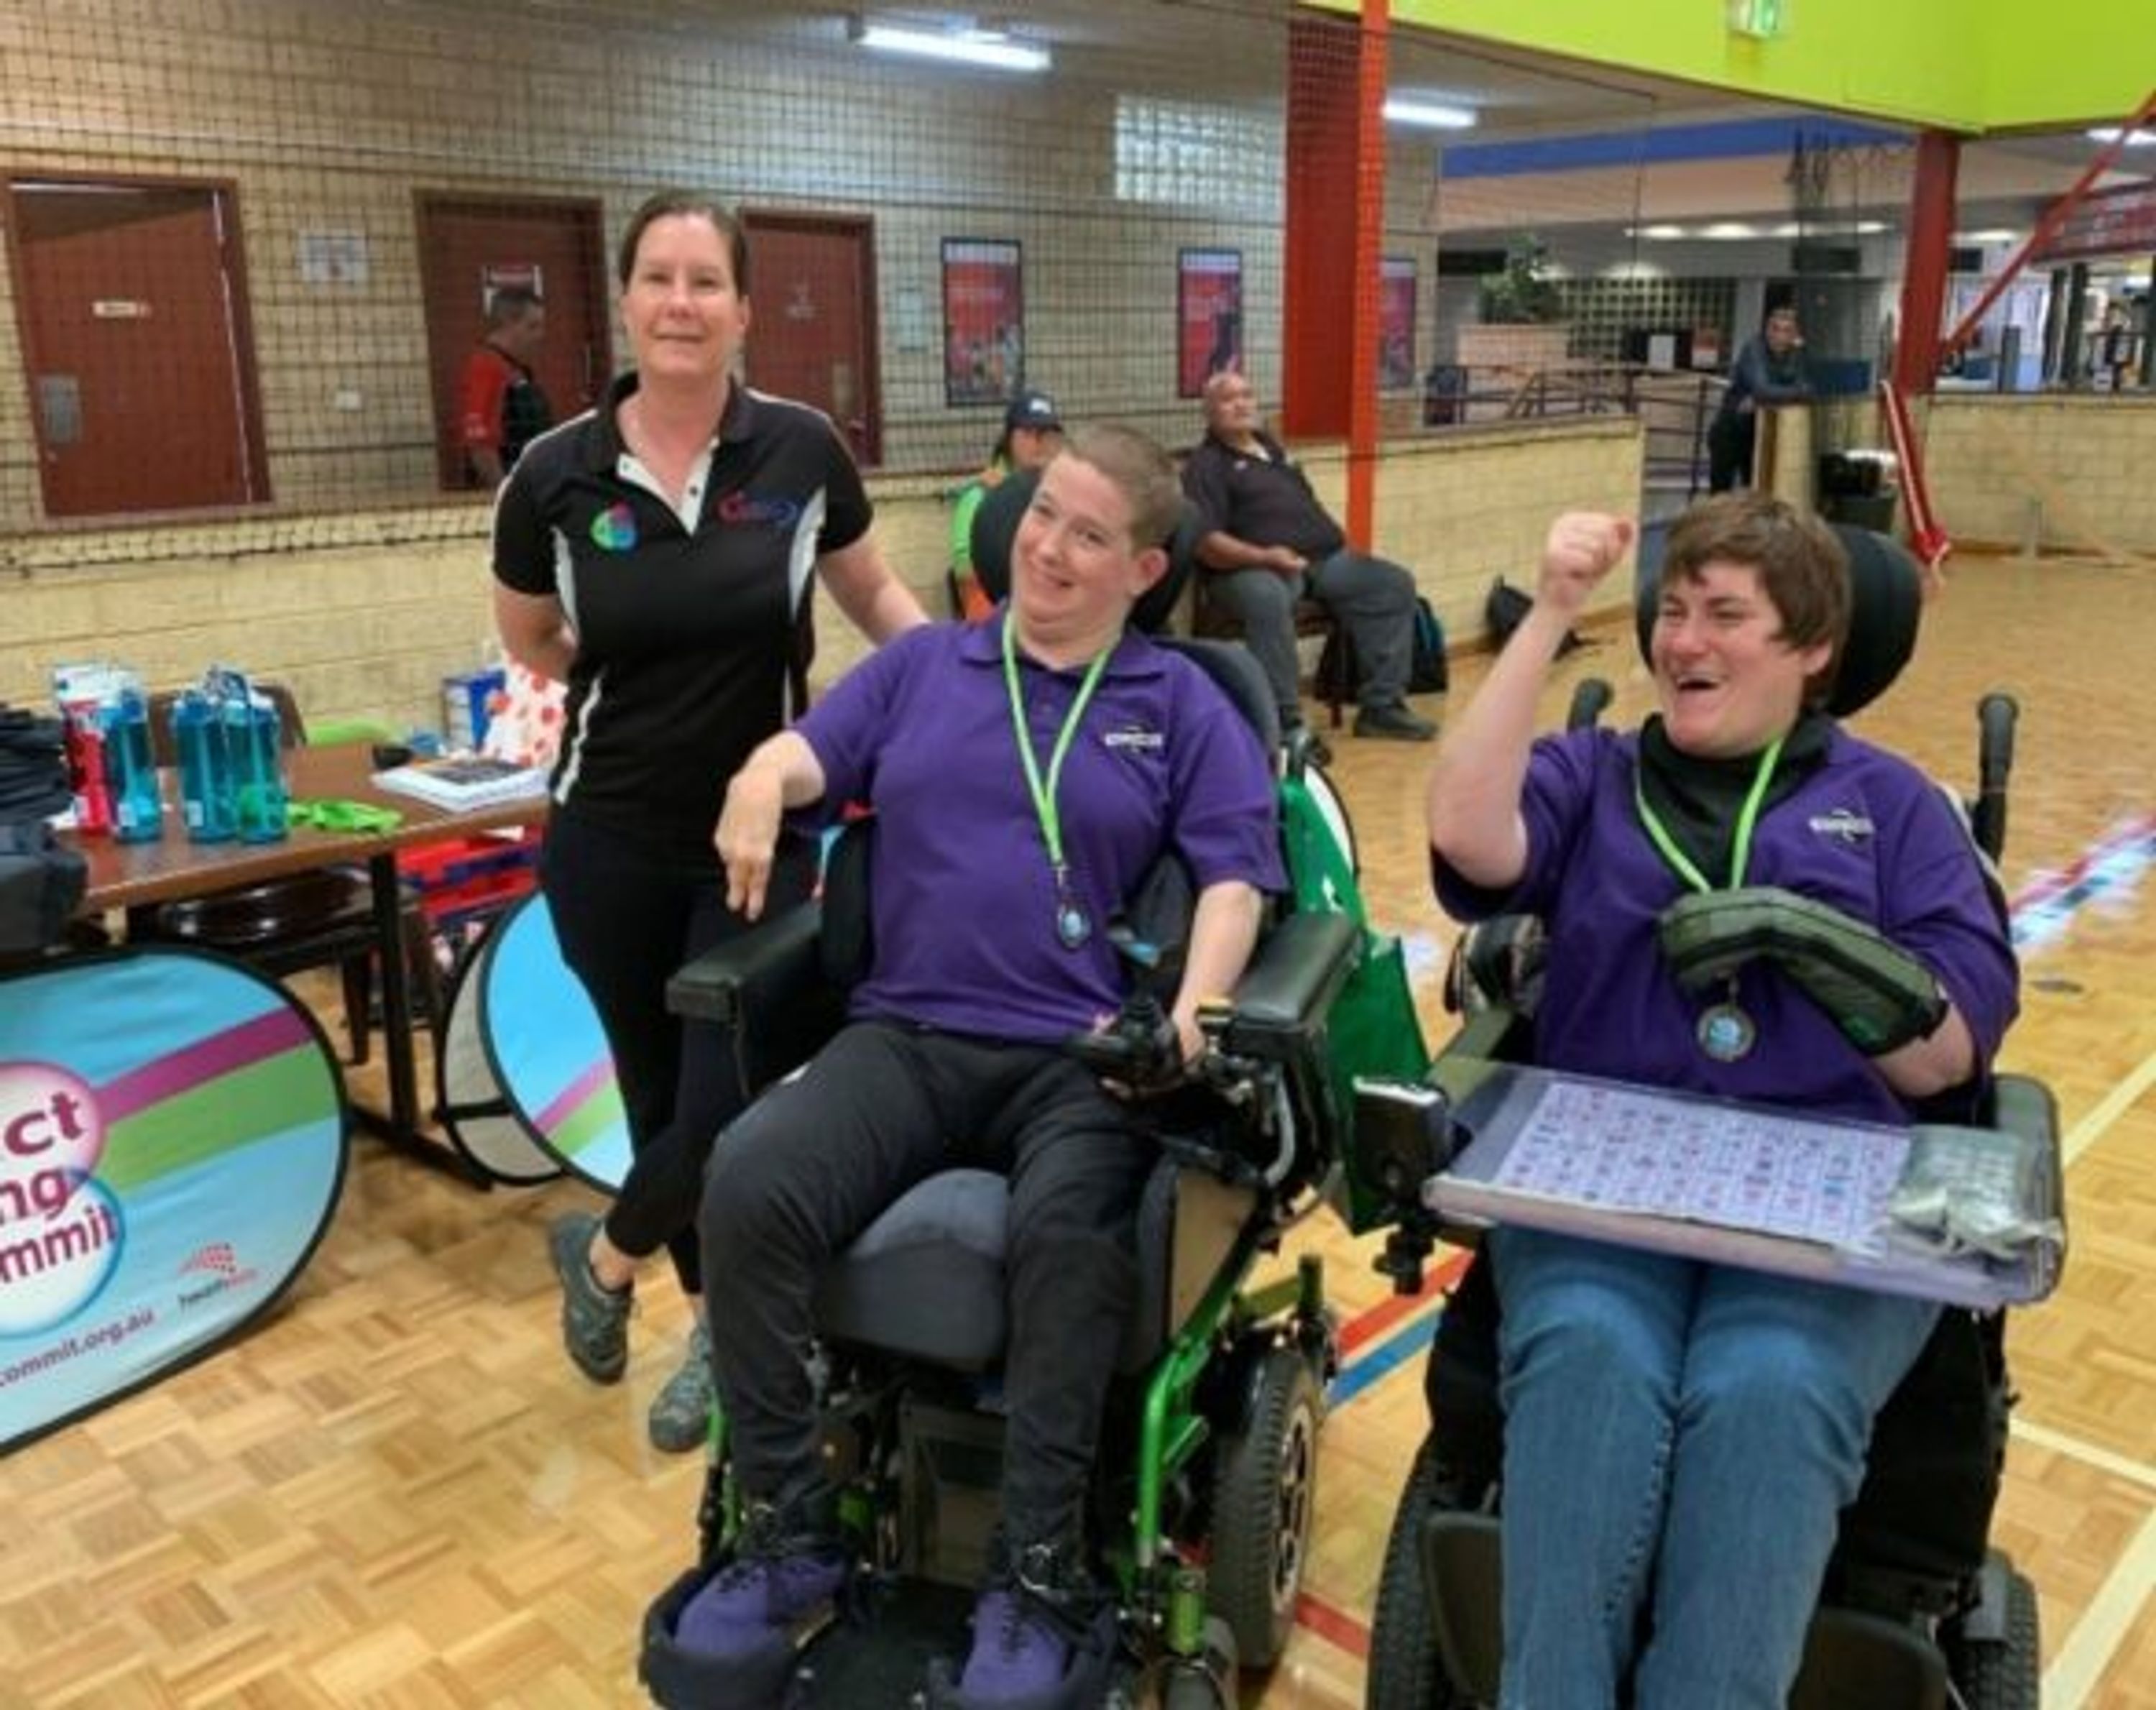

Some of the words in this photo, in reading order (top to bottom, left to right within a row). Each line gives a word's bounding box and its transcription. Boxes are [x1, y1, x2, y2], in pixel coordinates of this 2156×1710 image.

[4, 1091, 84, 1156] ct
[0, 1166, 70, 1223] ng
[0, 1204, 116, 1284] mmit
[0, 1307, 155, 1388] ommit.org.au
